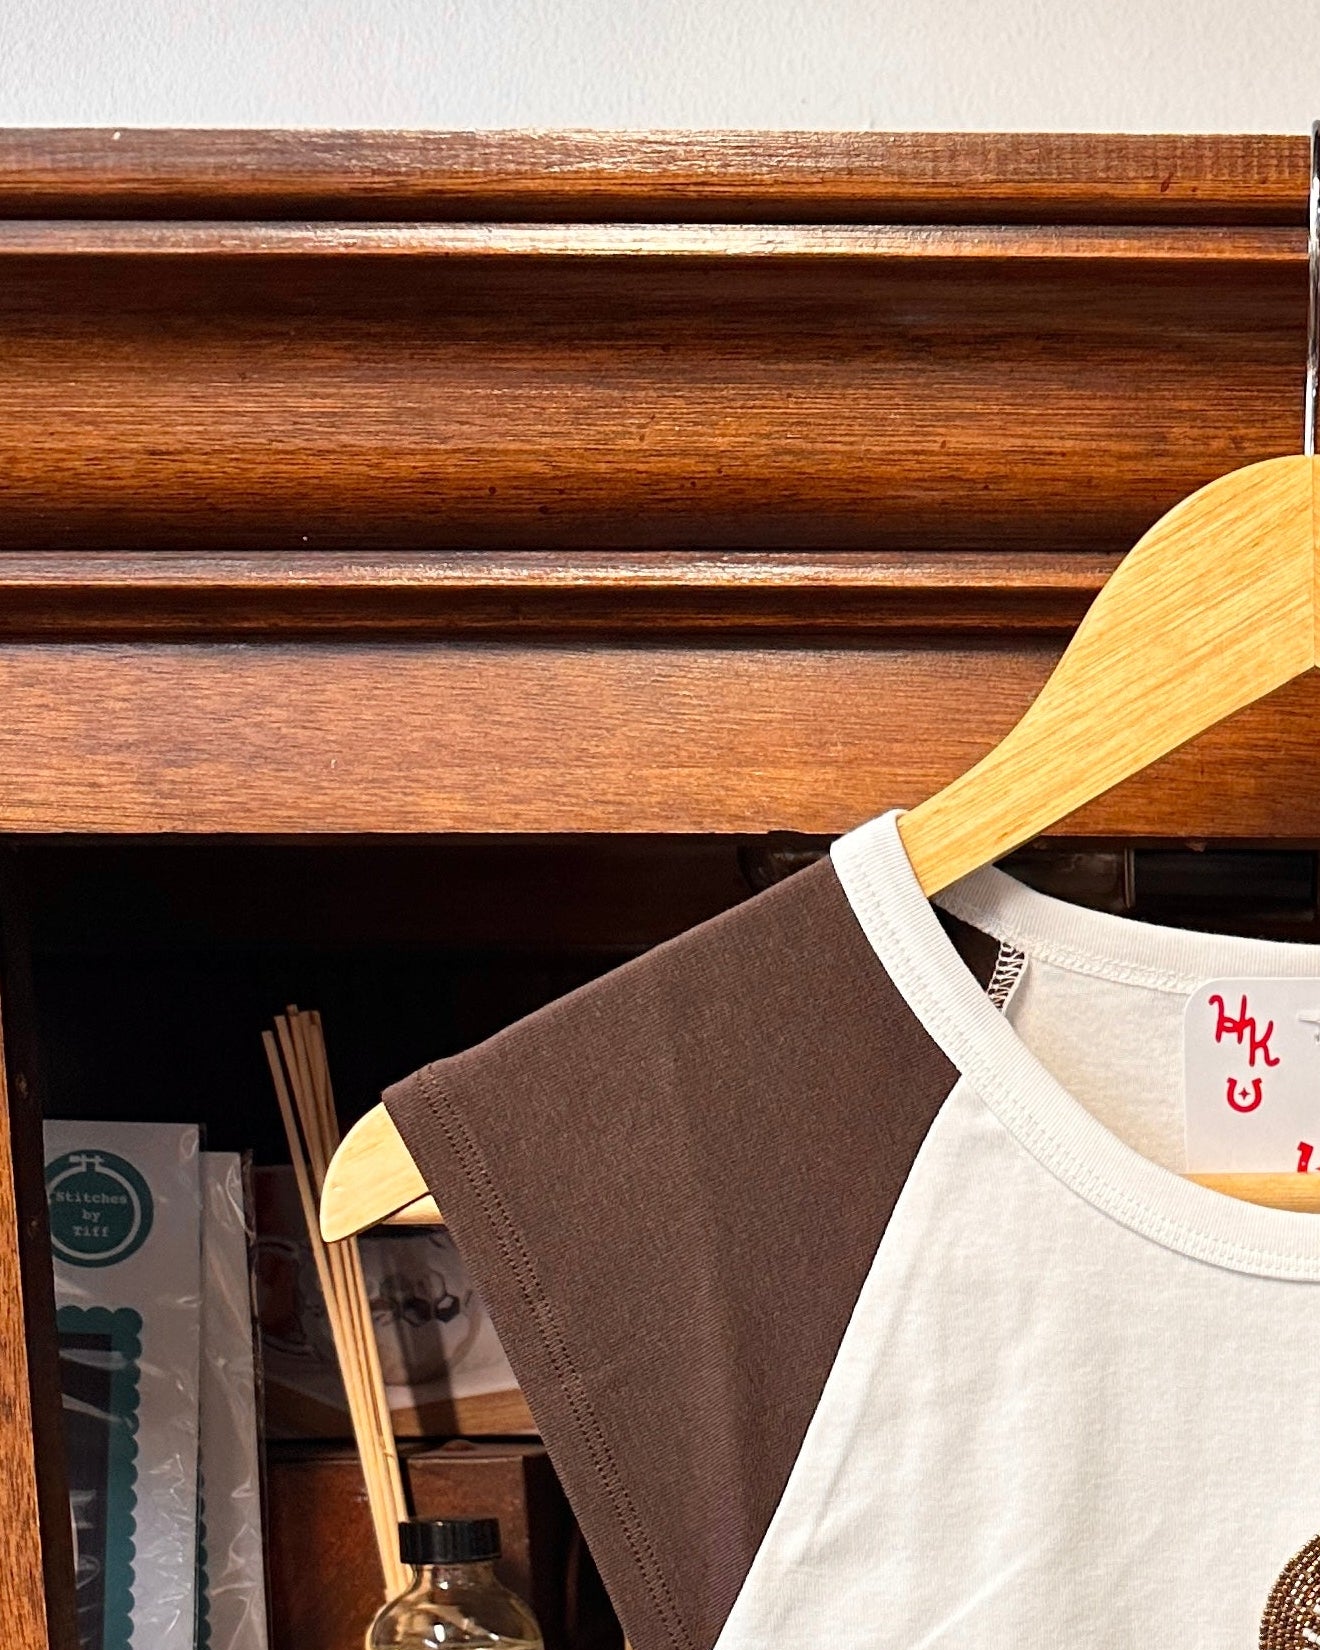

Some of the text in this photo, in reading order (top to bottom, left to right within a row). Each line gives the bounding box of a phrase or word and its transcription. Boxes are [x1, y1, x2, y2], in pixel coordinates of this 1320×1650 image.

[55, 1190, 128, 1205] Stitches
[82, 1208, 100, 1223] by
[72, 1225, 109, 1238] Tiff
